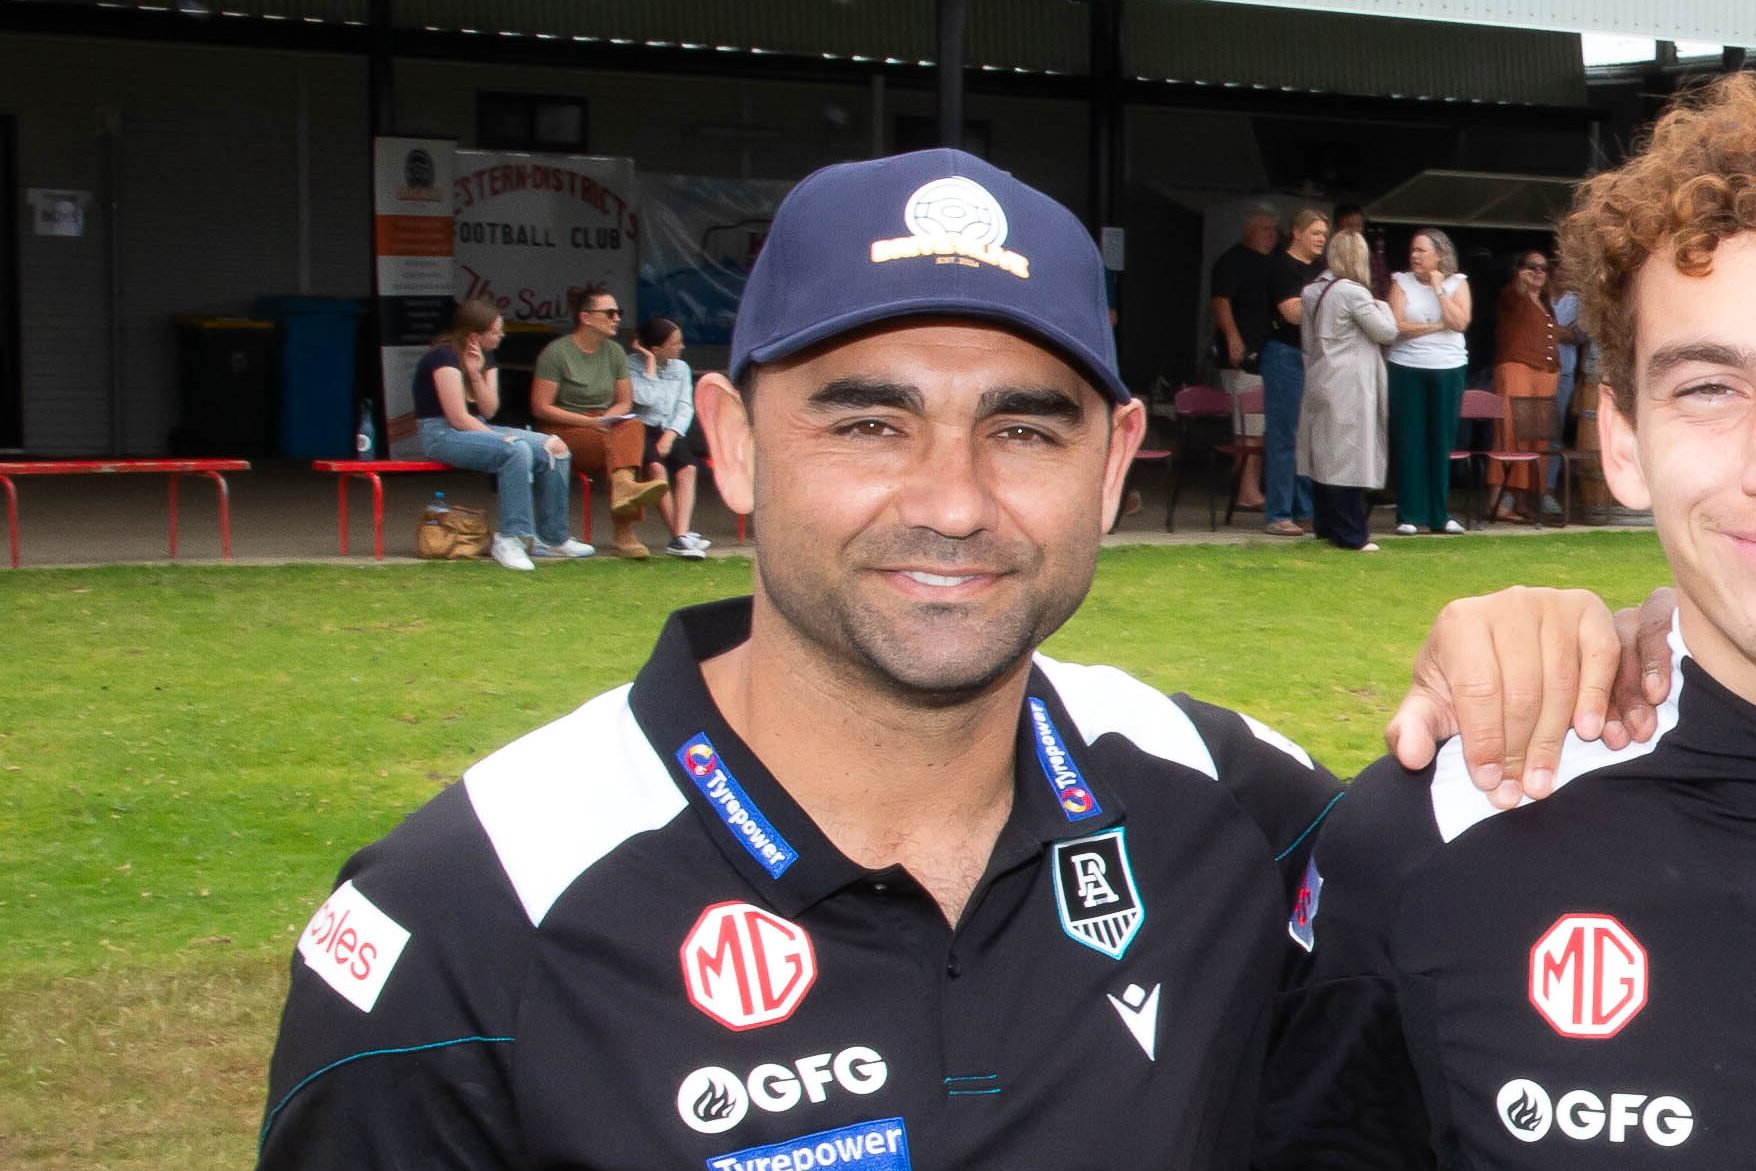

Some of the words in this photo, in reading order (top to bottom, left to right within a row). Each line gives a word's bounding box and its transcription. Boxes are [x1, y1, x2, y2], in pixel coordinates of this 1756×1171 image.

[455, 222, 555, 247] OOTBALL
[571, 227, 621, 249] CLUB
[1030, 700, 1077, 789] Tyrepower
[706, 768, 786, 864] Tyrepower
[696, 911, 804, 1017] MG
[1542, 926, 1636, 1026] MG
[747, 1046, 888, 1113] GFG
[1556, 1089, 1695, 1147] GFG
